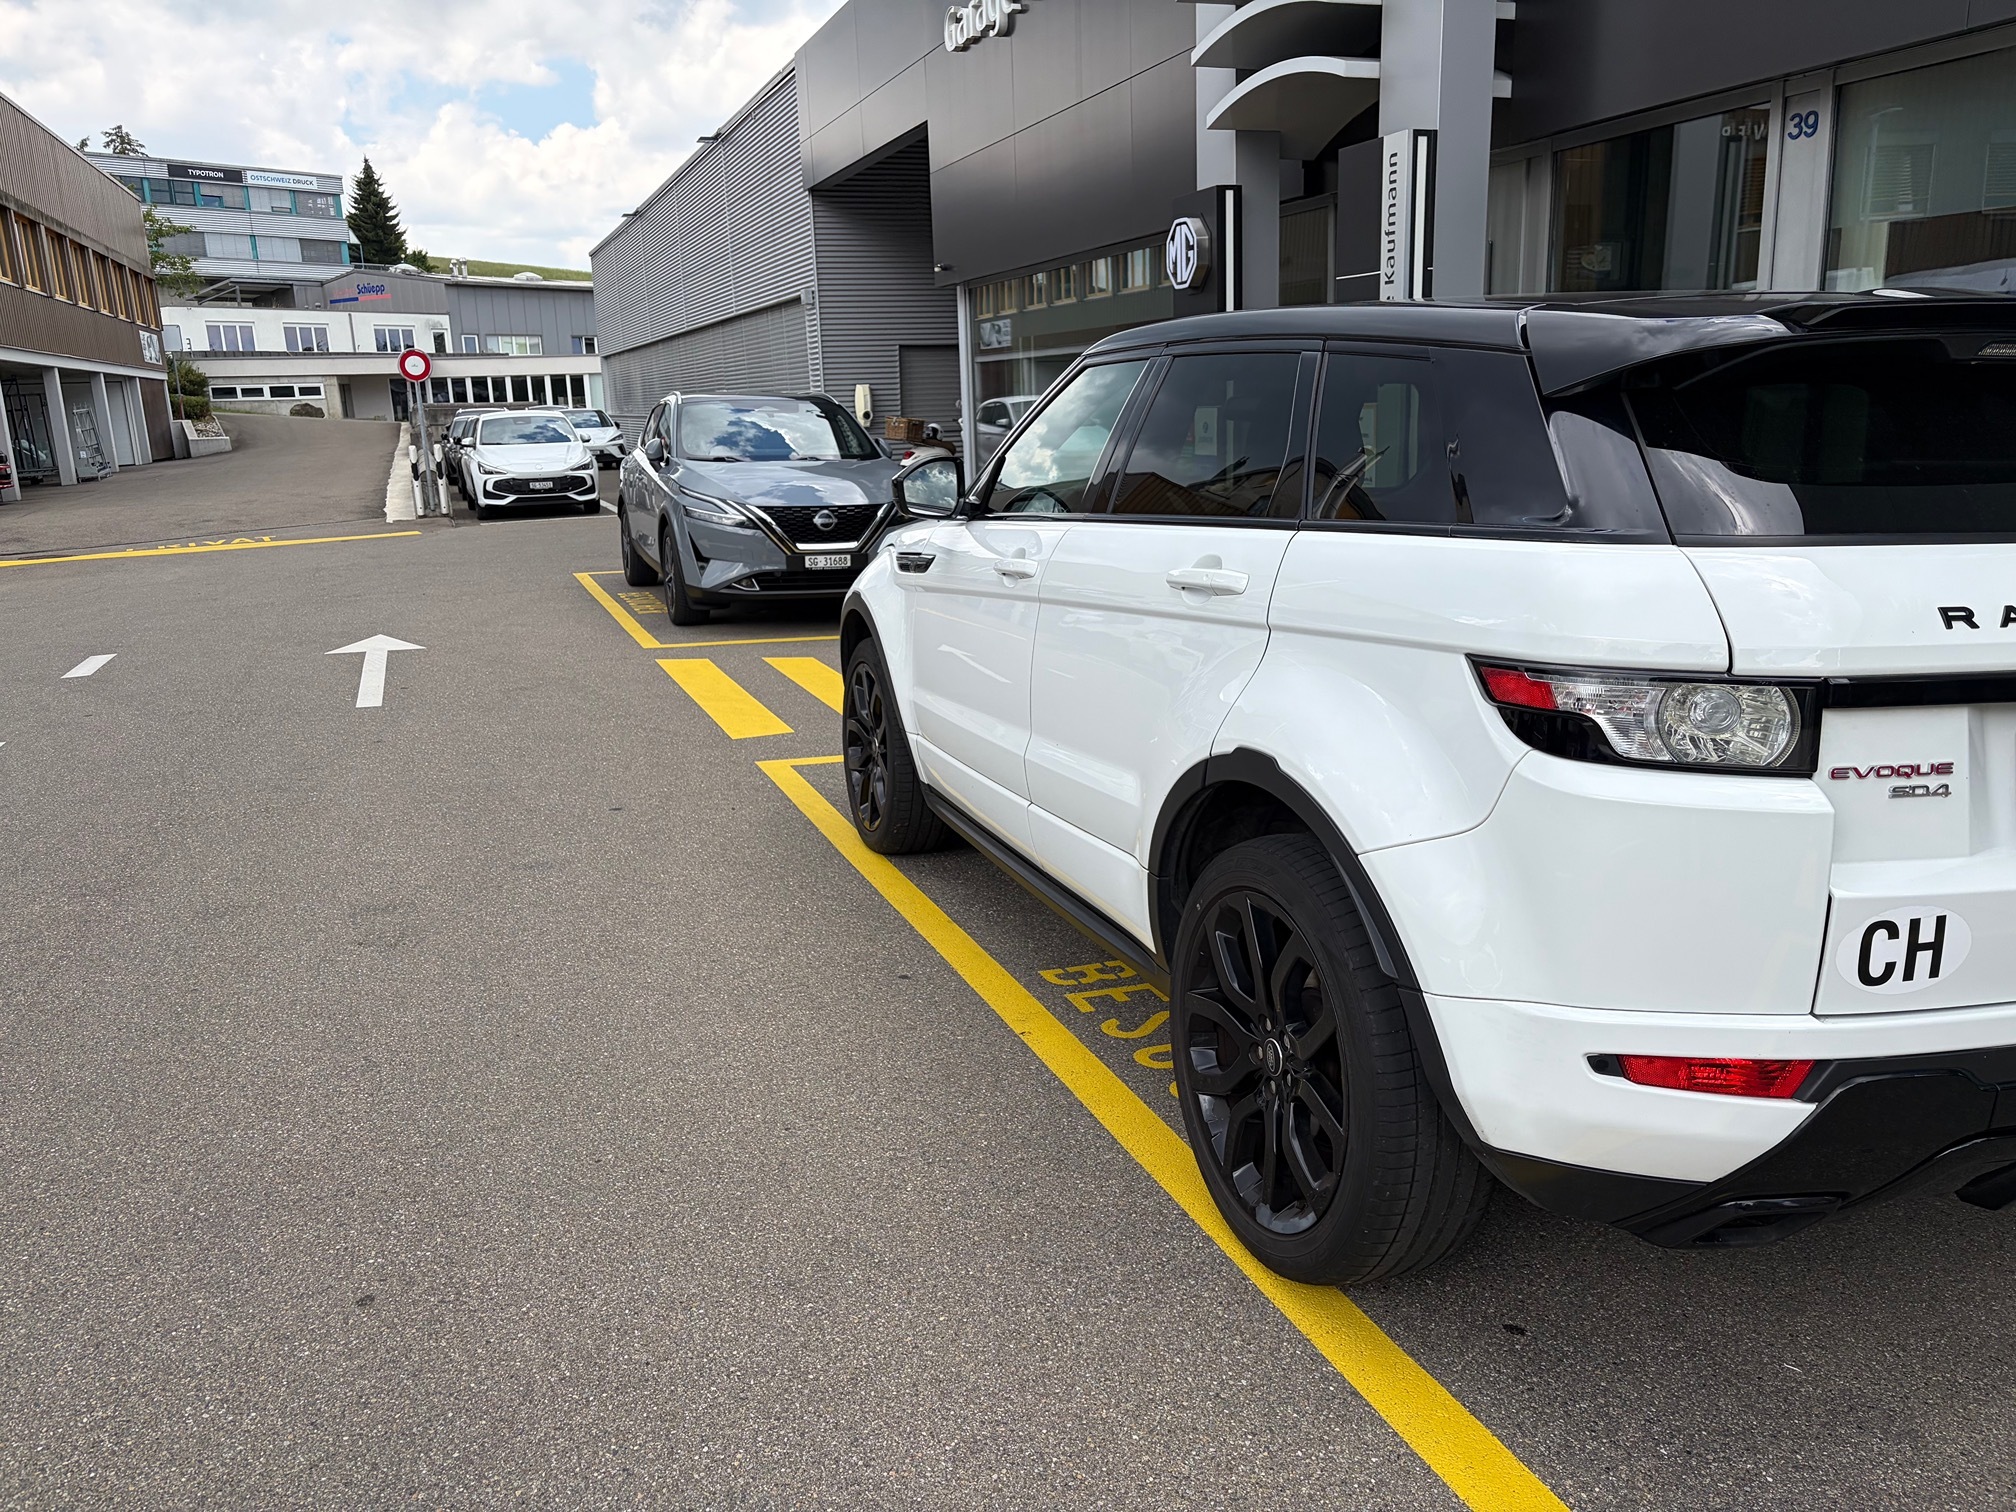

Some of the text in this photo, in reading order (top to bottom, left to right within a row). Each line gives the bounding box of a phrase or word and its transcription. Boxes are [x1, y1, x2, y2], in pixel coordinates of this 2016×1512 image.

[1787, 110, 1819, 140] 39
[187, 169, 224, 178] TYPOTRON
[250, 174, 314, 186] OSTSCHWEIZ DRUCK
[1384, 152, 1398, 285] Kaufmann
[1169, 223, 1195, 283] MG
[808, 556, 848, 566] SG 31688
[1828, 762, 1955, 780] EVOQUE
[1888, 783, 1951, 799] SD4
[1857, 914, 1947, 987] CH
